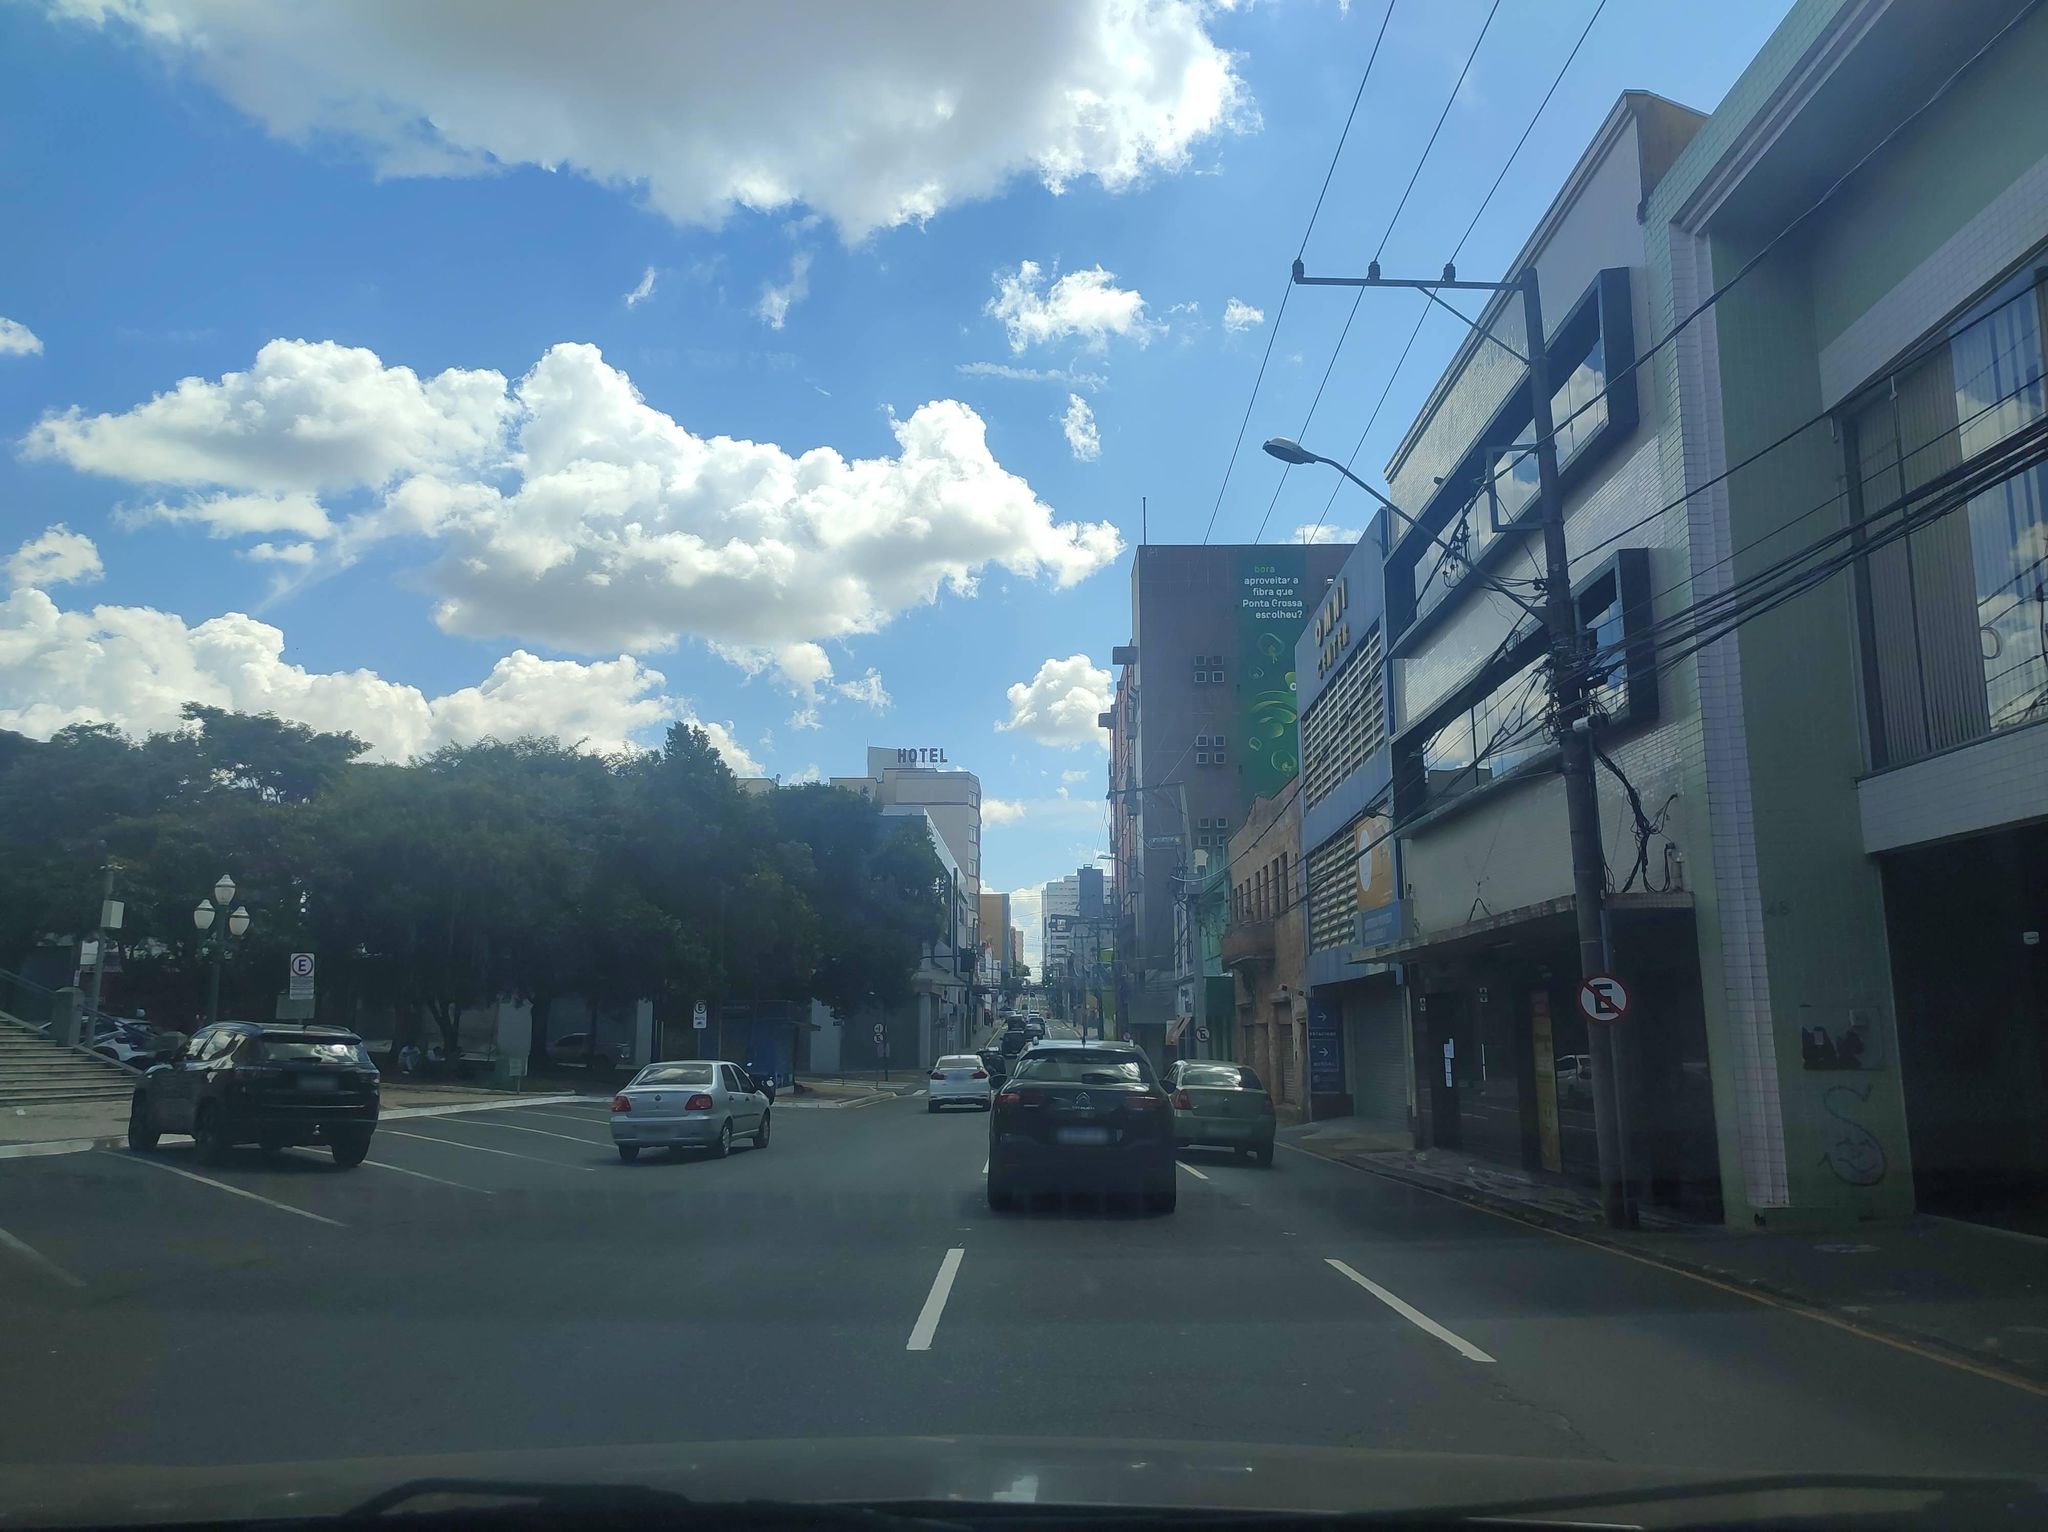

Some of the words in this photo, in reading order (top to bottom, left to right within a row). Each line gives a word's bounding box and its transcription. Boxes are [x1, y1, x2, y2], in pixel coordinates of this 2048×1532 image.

[1254, 565, 1275, 573] bora
[1244, 576, 1290, 586] aproveitar
[1293, 577, 1299, 585] a
[1252, 587, 1274, 596] fibra
[1276, 588, 1294, 597] que
[1242, 599, 1270, 608] Ponta
[1271, 598, 1303, 608] Grossa
[1255, 610, 1303, 619] escolheu?
[1315, 576, 1347, 647] OMNI
[1318, 622, 1349, 680] CENTER
[897, 748, 948, 763] HOTEL
[298, 959, 307, 972] E
[1593, 984, 1616, 1013] E
